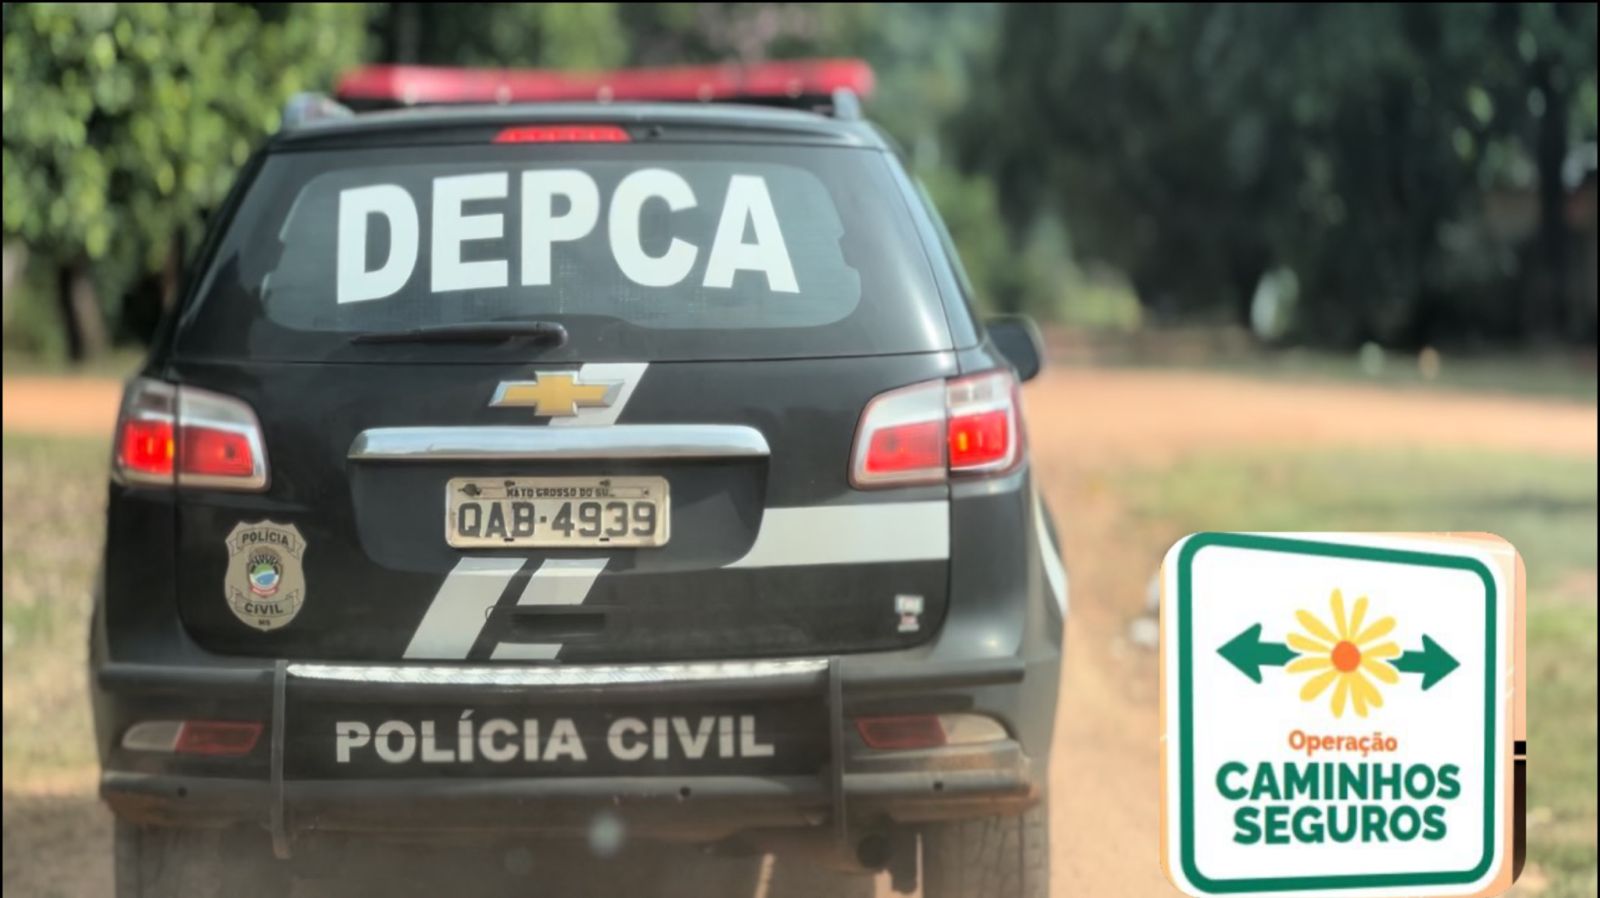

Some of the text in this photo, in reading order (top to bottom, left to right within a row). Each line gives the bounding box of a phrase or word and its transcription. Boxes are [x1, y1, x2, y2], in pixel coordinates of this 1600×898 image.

[337, 168, 800, 304] DEPCA
[536, 487, 577, 497] GROSSO
[580, 487, 593, 497] DO
[242, 530, 289, 546] POLÍCIA
[244, 602, 284, 615] CIVIL
[336, 709, 775, 763] POLÍCIA CIVIL
